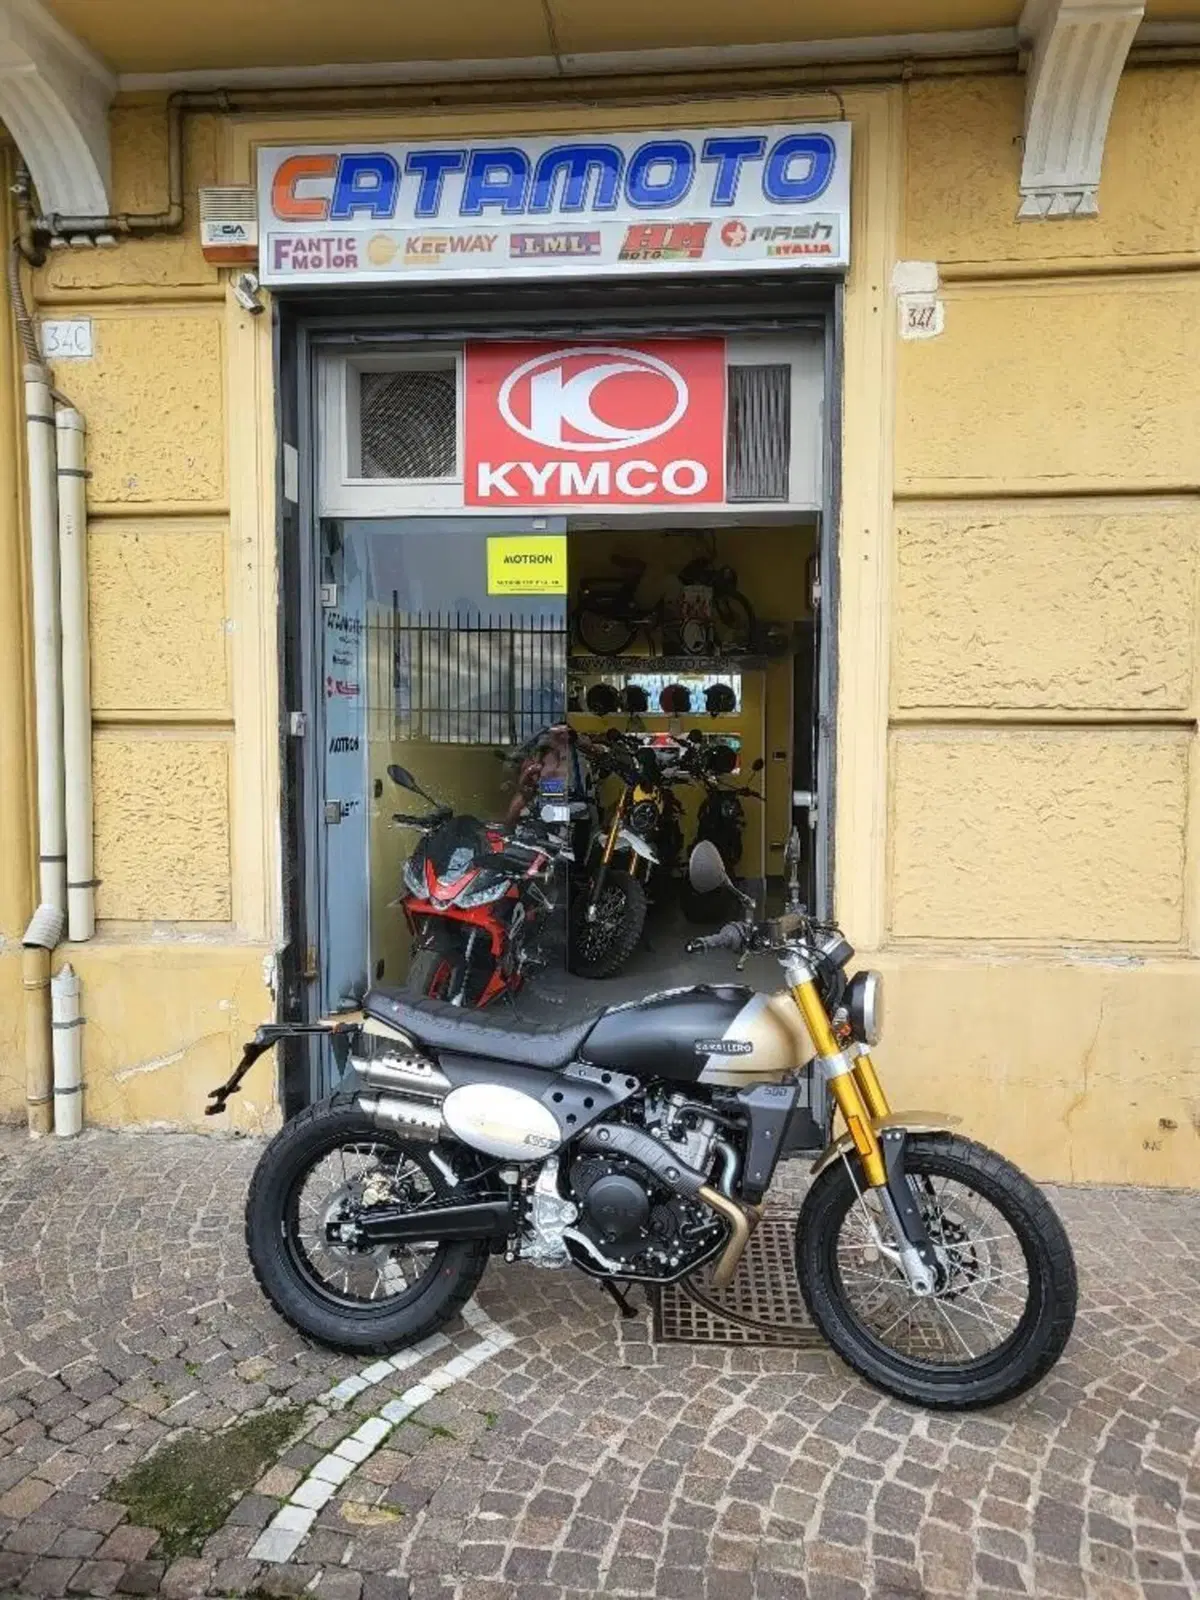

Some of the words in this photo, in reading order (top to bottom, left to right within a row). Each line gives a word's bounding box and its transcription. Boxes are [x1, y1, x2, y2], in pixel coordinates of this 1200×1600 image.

[272, 133, 836, 221] CATAMOTO
[405, 234, 498, 254] KEEWAY
[291, 252, 358, 270] MOTOR
[478, 459, 709, 497] KYMCO
[503, 555, 553, 564] MOTRON
